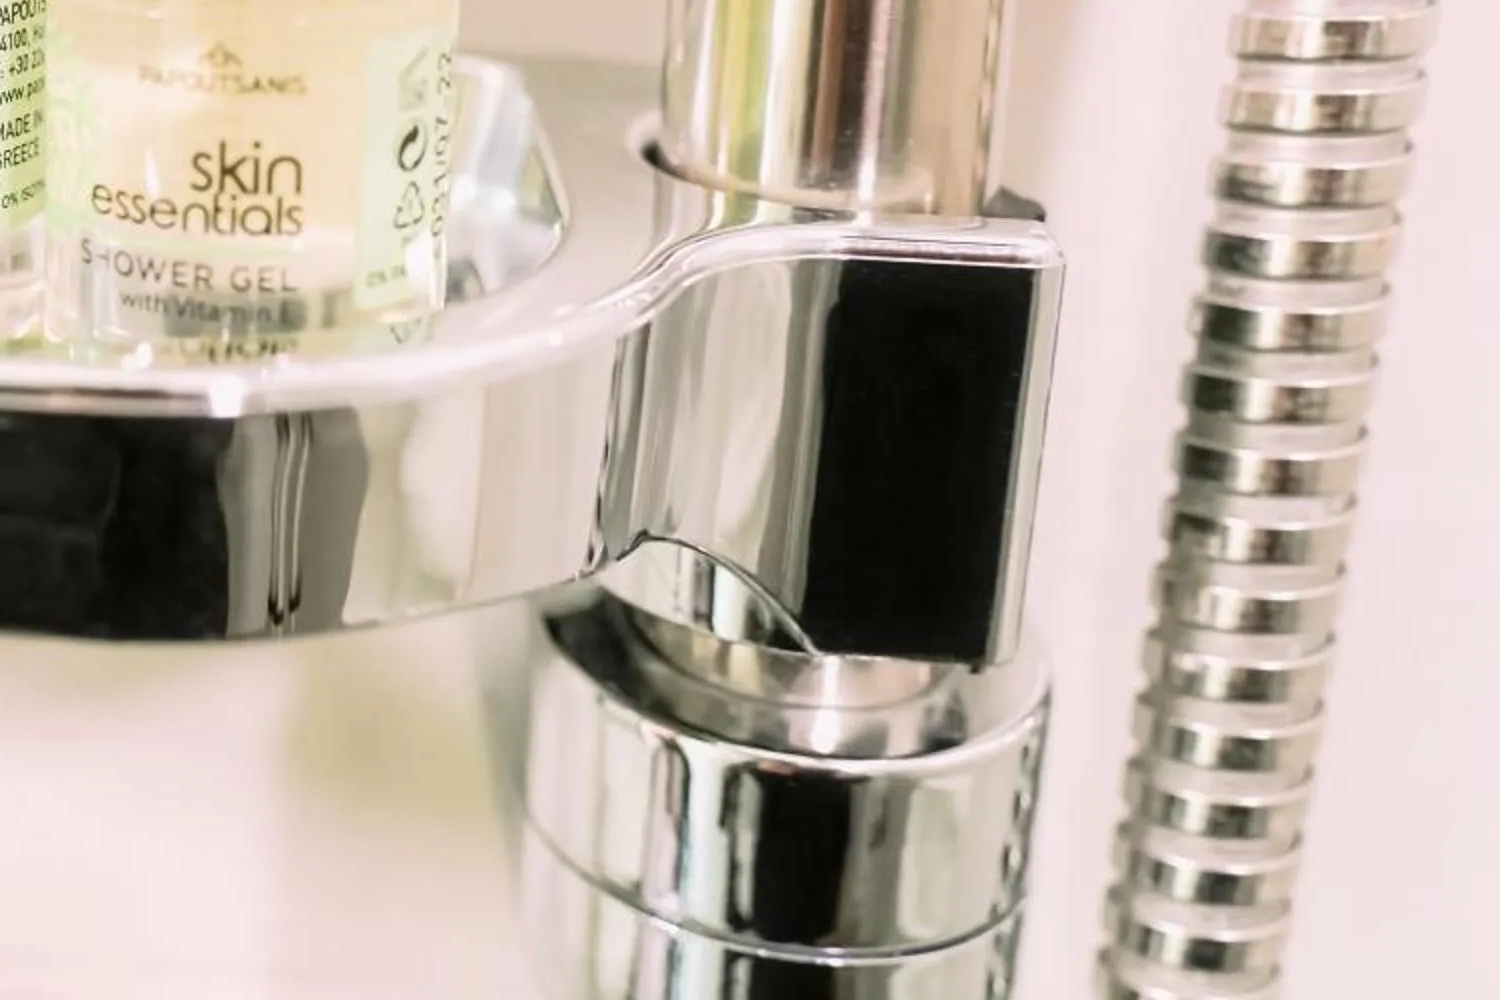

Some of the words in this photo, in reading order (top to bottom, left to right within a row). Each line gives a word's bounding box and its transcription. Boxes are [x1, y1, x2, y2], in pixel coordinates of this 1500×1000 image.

[189, 140, 305, 195] skin
[90, 183, 305, 237] essentials
[230, 263, 300, 294] GEL
[120, 292, 167, 315] with
